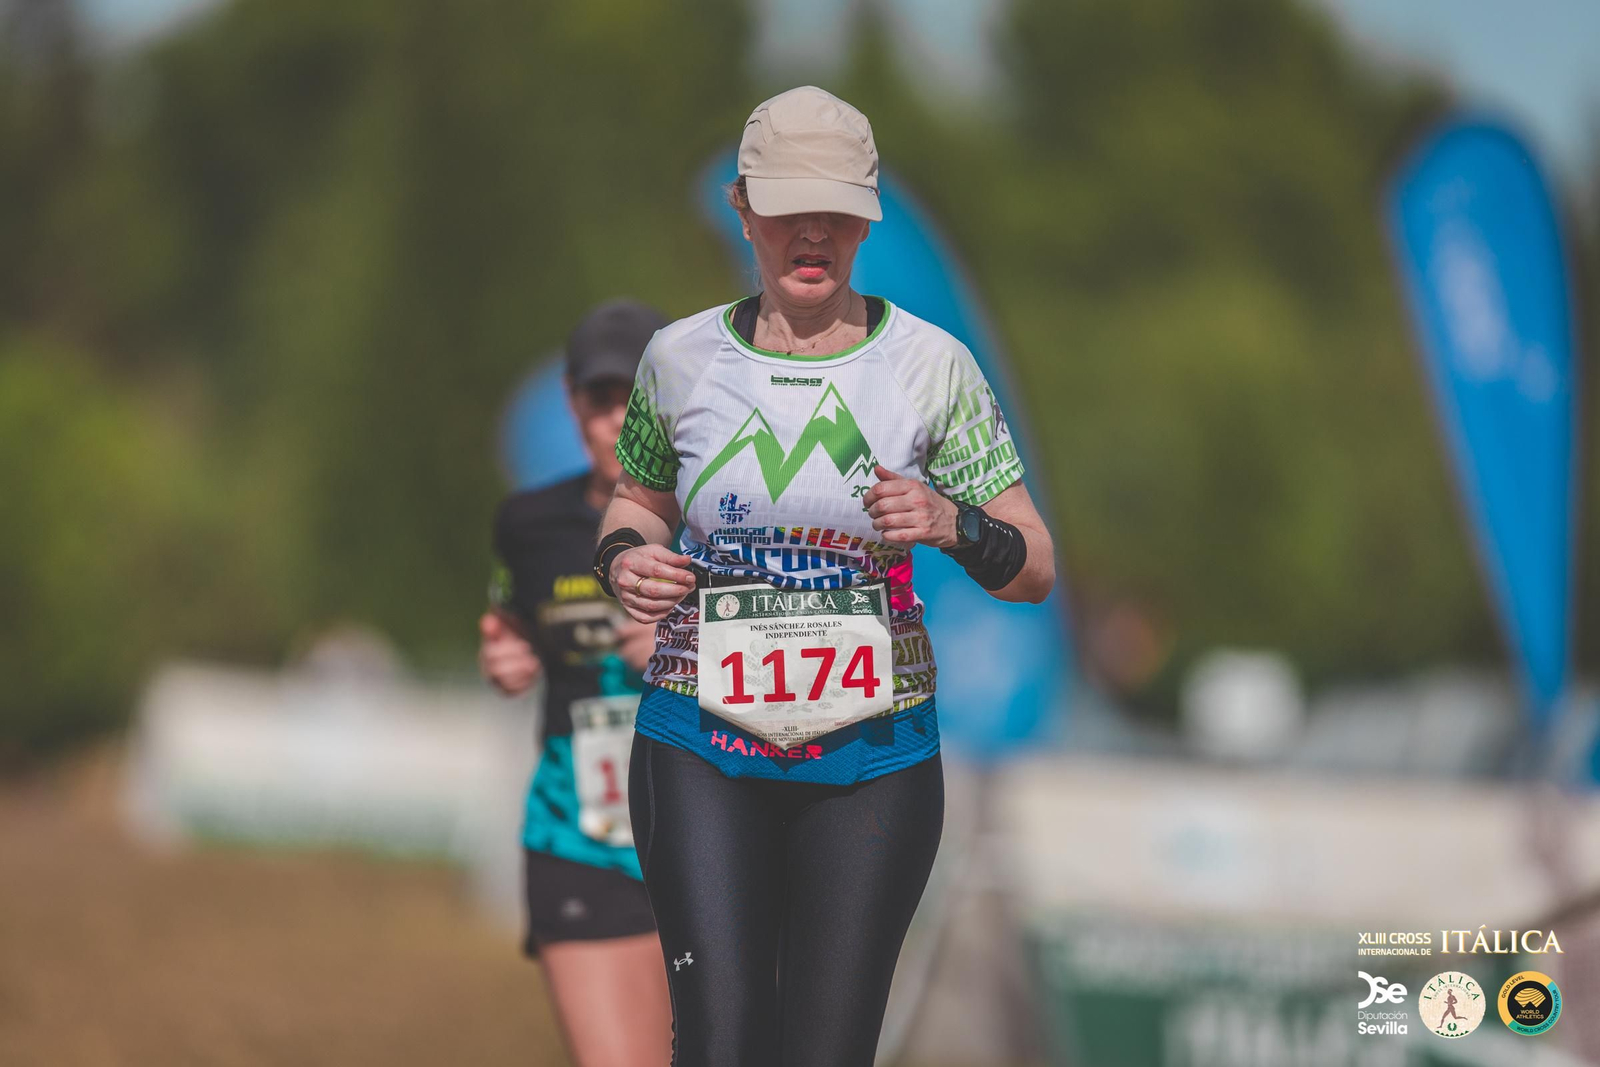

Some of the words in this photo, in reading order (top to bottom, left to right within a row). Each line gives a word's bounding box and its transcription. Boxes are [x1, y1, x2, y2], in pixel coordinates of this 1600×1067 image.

[752, 591, 838, 612] ITÁLICA
[750, 623, 768, 631] INÉS
[769, 622, 806, 631] SÁNCHEZ
[807, 620, 843, 629] ROSALES
[765, 630, 828, 639] INDEPENDIENTE
[721, 646, 881, 705] 1174
[711, 730, 822, 759] HANKER
